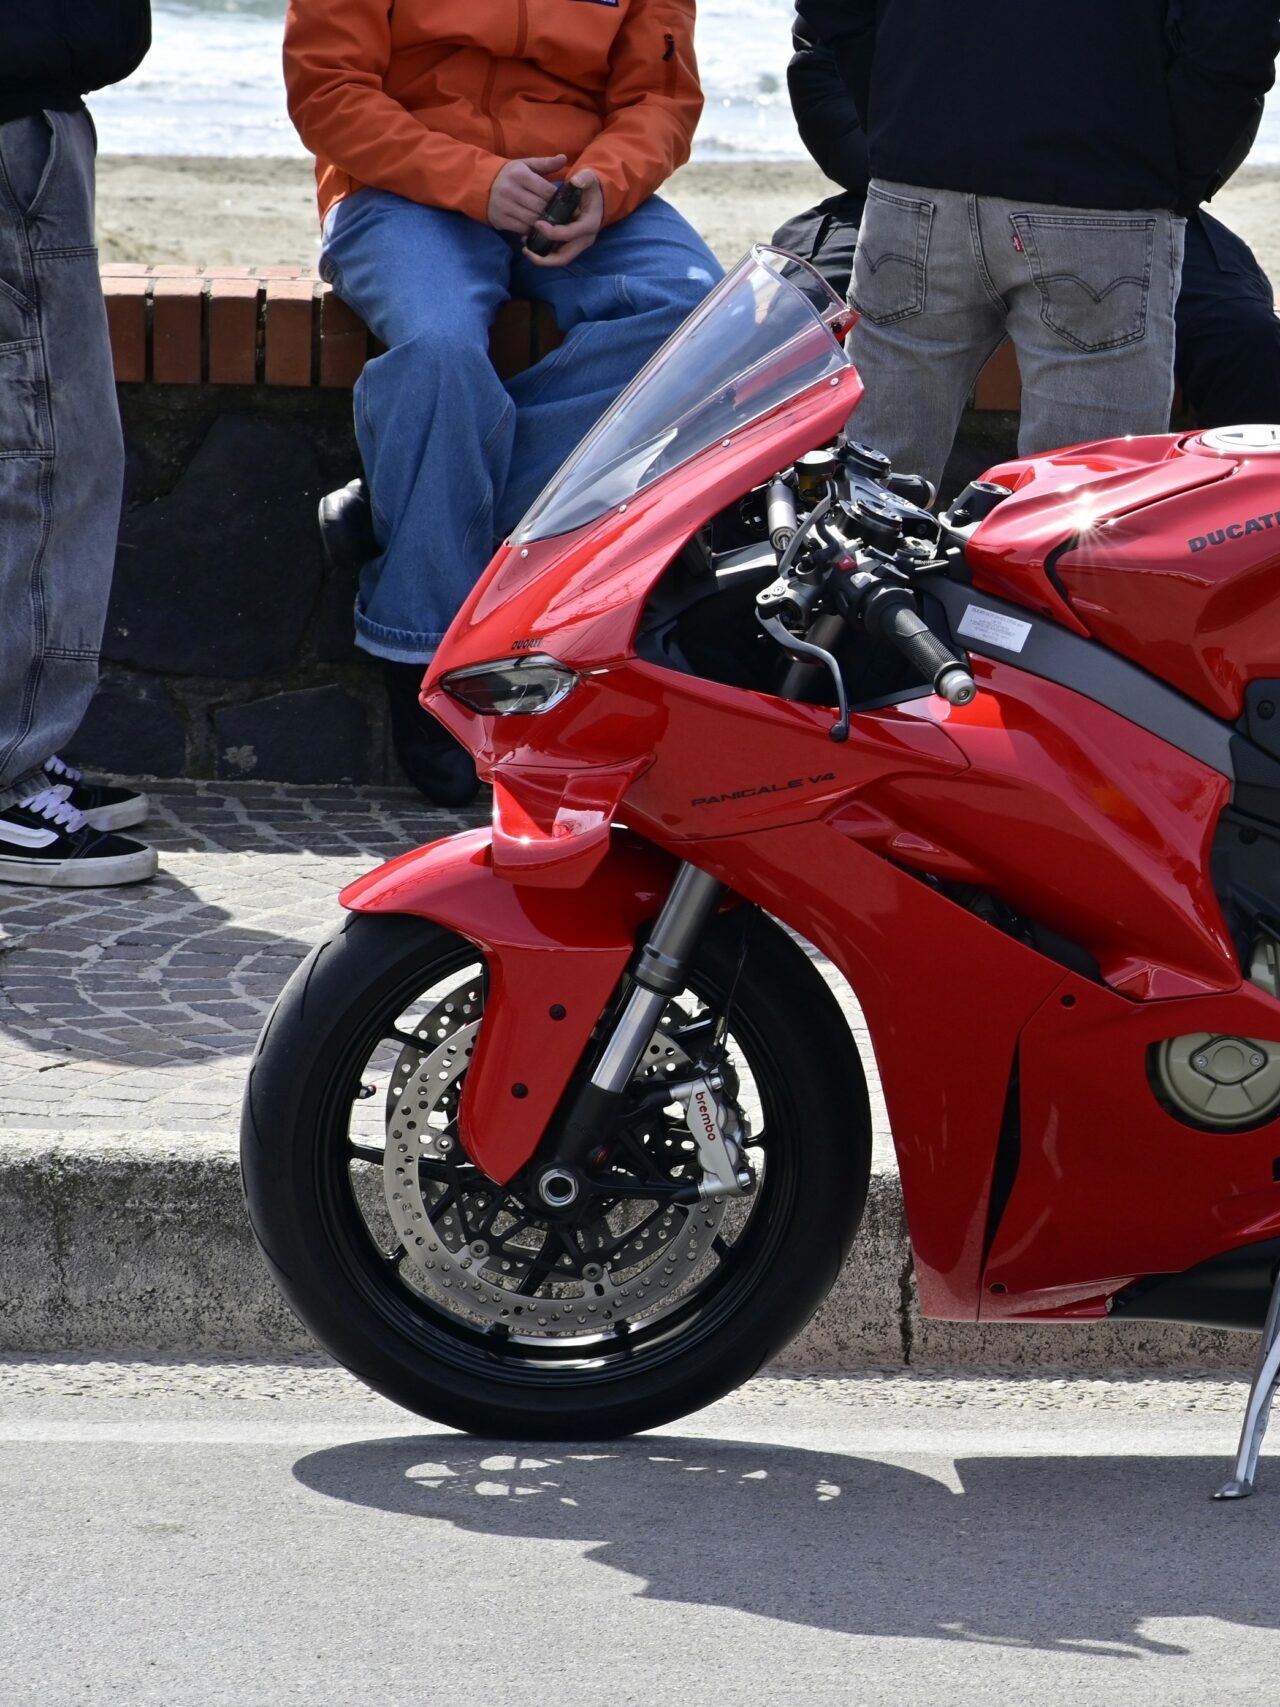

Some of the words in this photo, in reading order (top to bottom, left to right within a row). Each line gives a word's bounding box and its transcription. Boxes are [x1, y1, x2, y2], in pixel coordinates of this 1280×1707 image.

[691, 778, 803, 807] PANIGALE
[808, 772, 836, 784] V4
[694, 1091, 716, 1141] brembo
